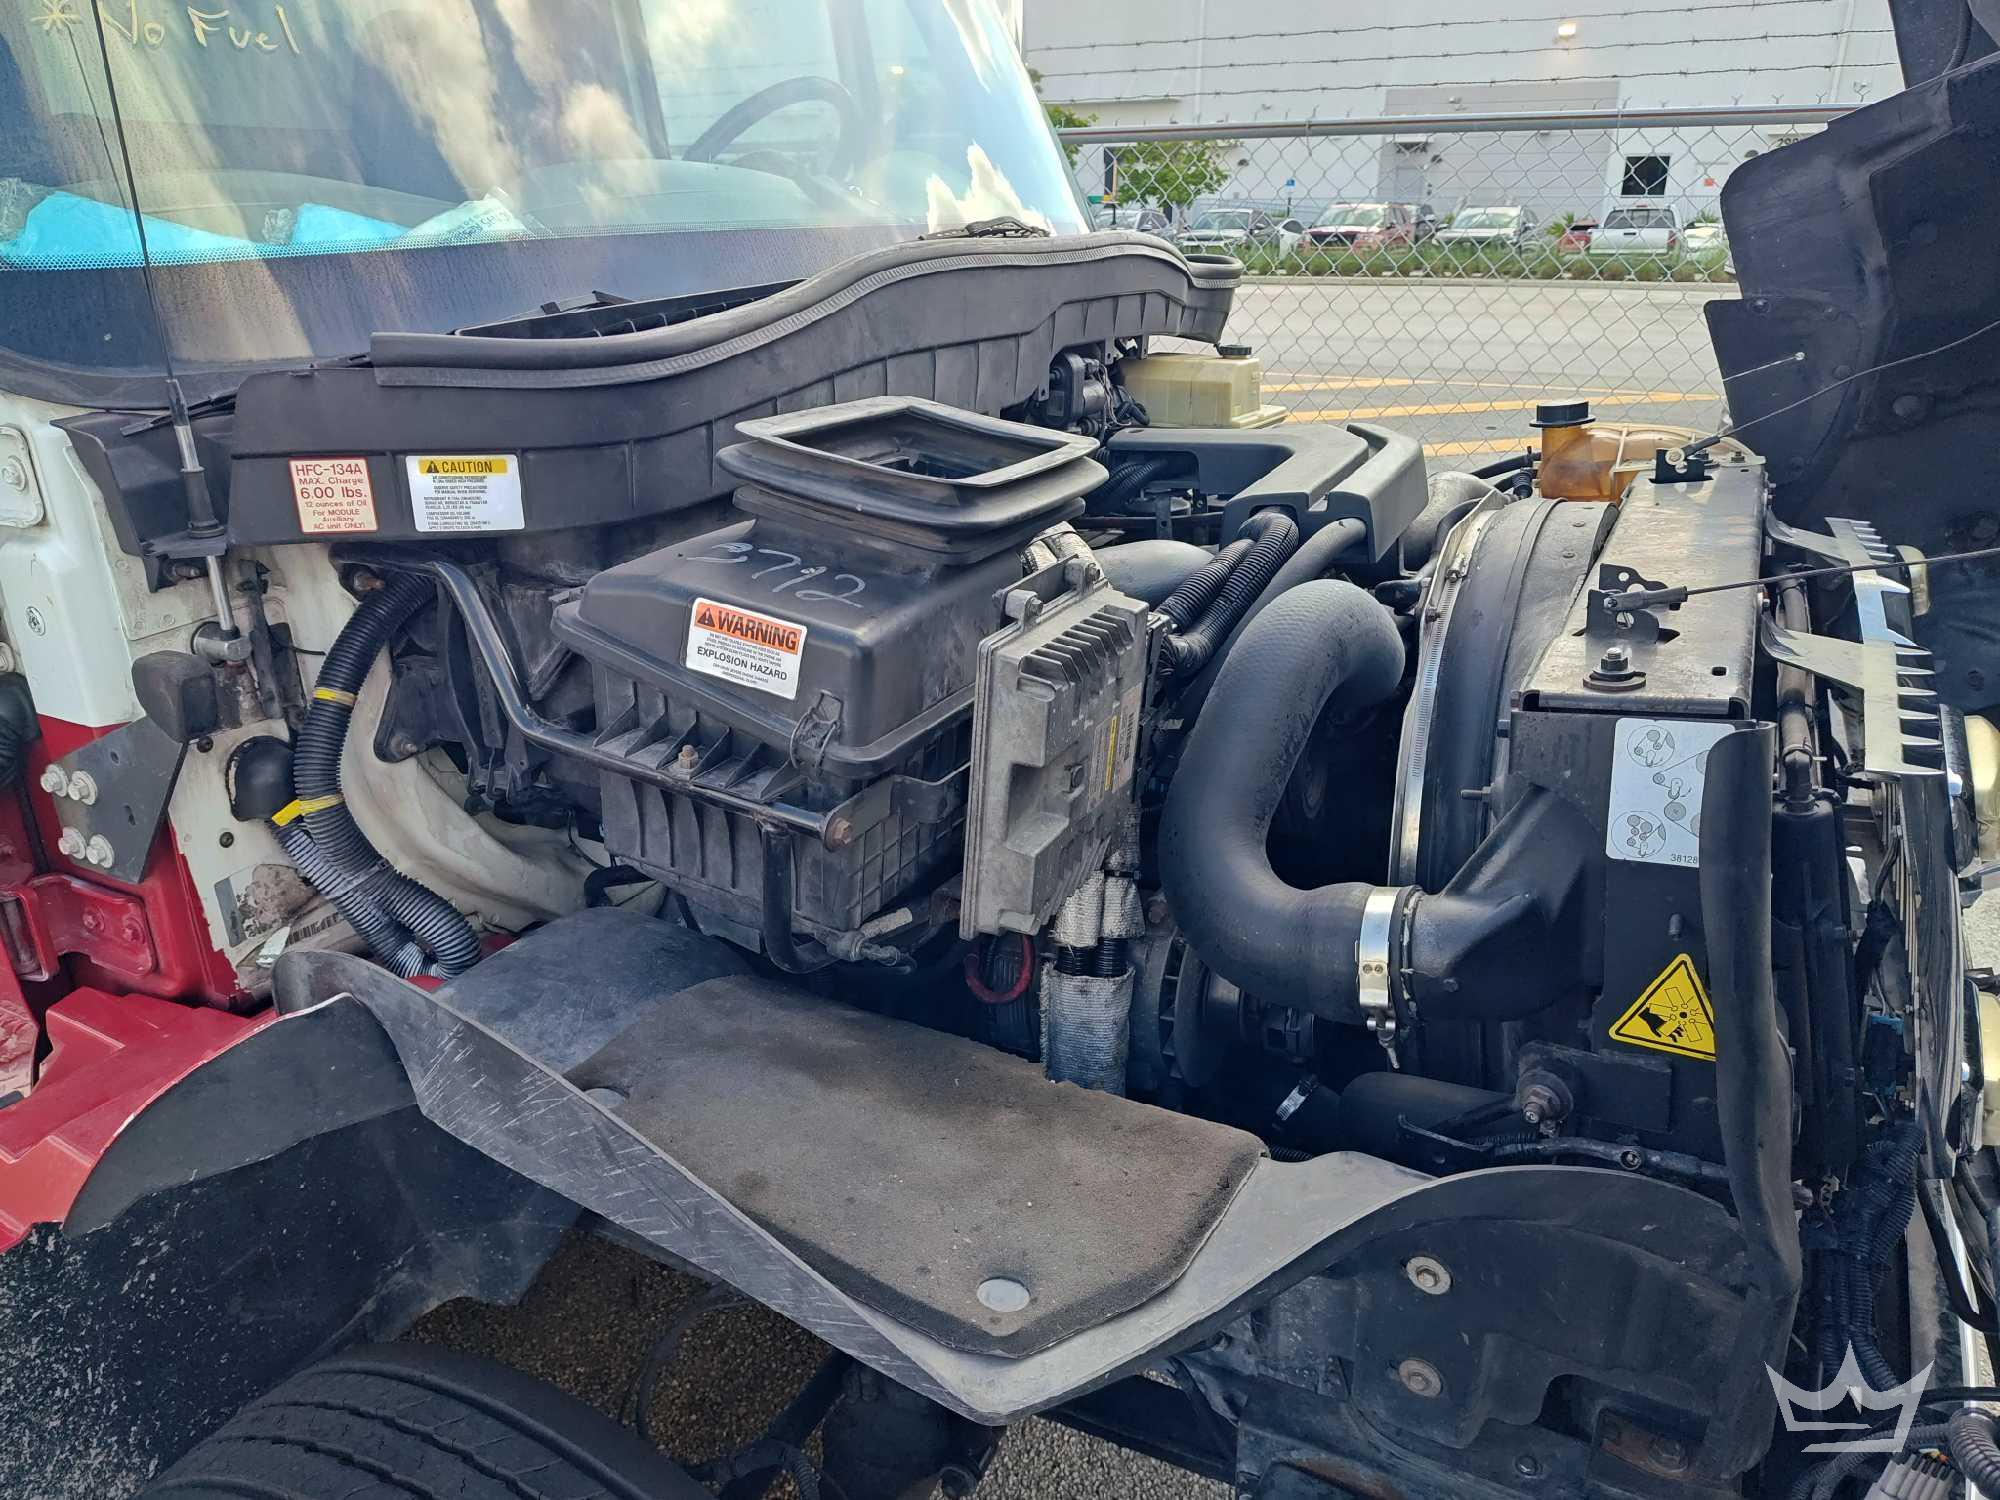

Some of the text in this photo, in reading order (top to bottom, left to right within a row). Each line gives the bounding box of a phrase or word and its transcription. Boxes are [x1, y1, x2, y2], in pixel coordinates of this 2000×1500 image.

[97, 0, 300, 54] No Fuel
[295, 463, 363, 476] HFC-134A
[441, 461, 493, 473] CAUTION
[328, 477, 364, 485] Charge
[300, 486, 368, 499] 6.00 lbs.
[328, 508, 360, 516] MODULE
[718, 609, 798, 651] WARNING
[697, 646, 748, 669] EXPLOSION
[750, 662, 788, 681] HAZARD
